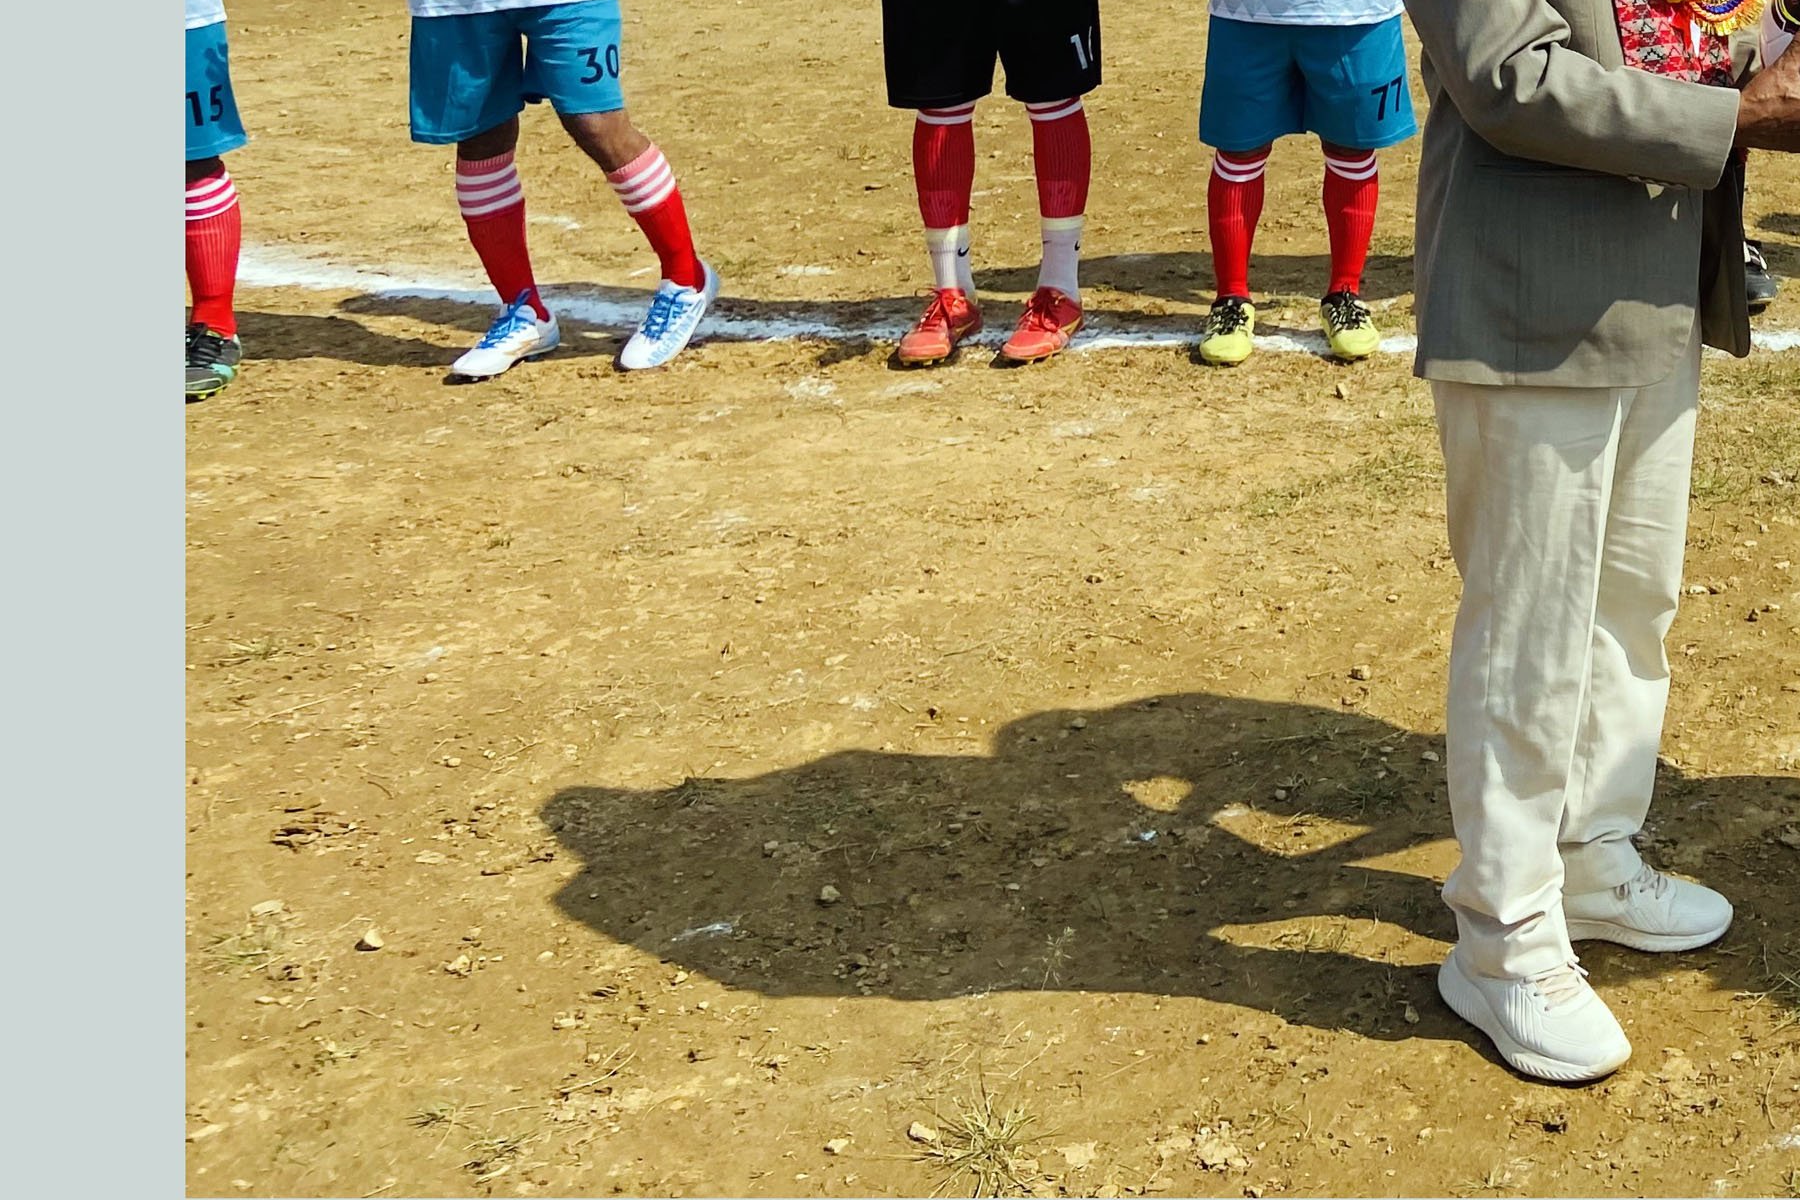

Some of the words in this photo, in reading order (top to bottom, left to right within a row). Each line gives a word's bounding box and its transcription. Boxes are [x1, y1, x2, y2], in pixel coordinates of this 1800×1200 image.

[577, 44, 619, 84] 30
[1070, 25, 1094, 70] 1
[185, 84, 224, 126] 15
[1371, 75, 1403, 122] 77
